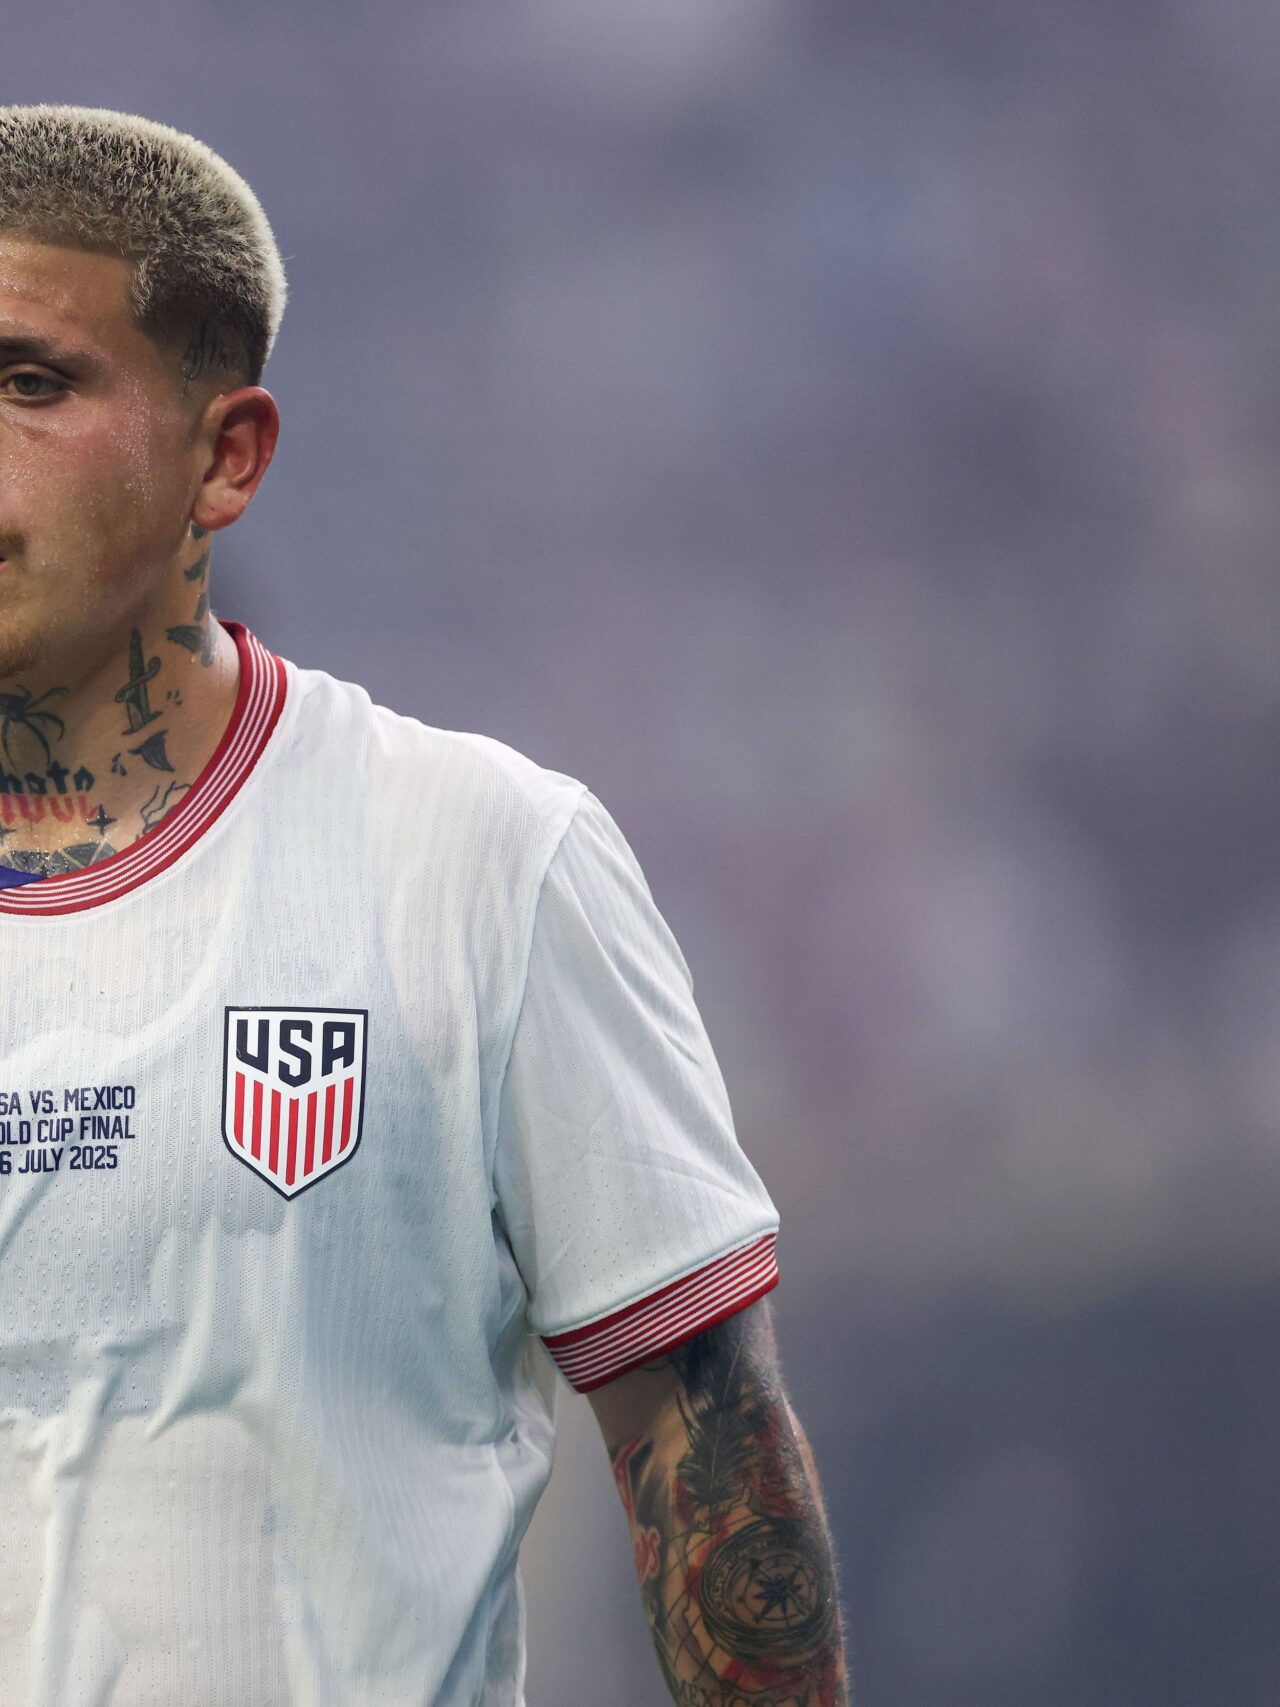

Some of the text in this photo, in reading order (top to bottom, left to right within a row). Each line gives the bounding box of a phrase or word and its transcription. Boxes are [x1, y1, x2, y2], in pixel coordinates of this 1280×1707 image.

[236, 1018, 356, 1088] USA
[29, 1089, 58, 1114] VS.
[63, 1085, 136, 1112] MEXICO
[37, 1117, 74, 1143] CUP
[79, 1115, 136, 1140] FINAL
[0, 1145, 118, 1174] 6 JULY 2025
